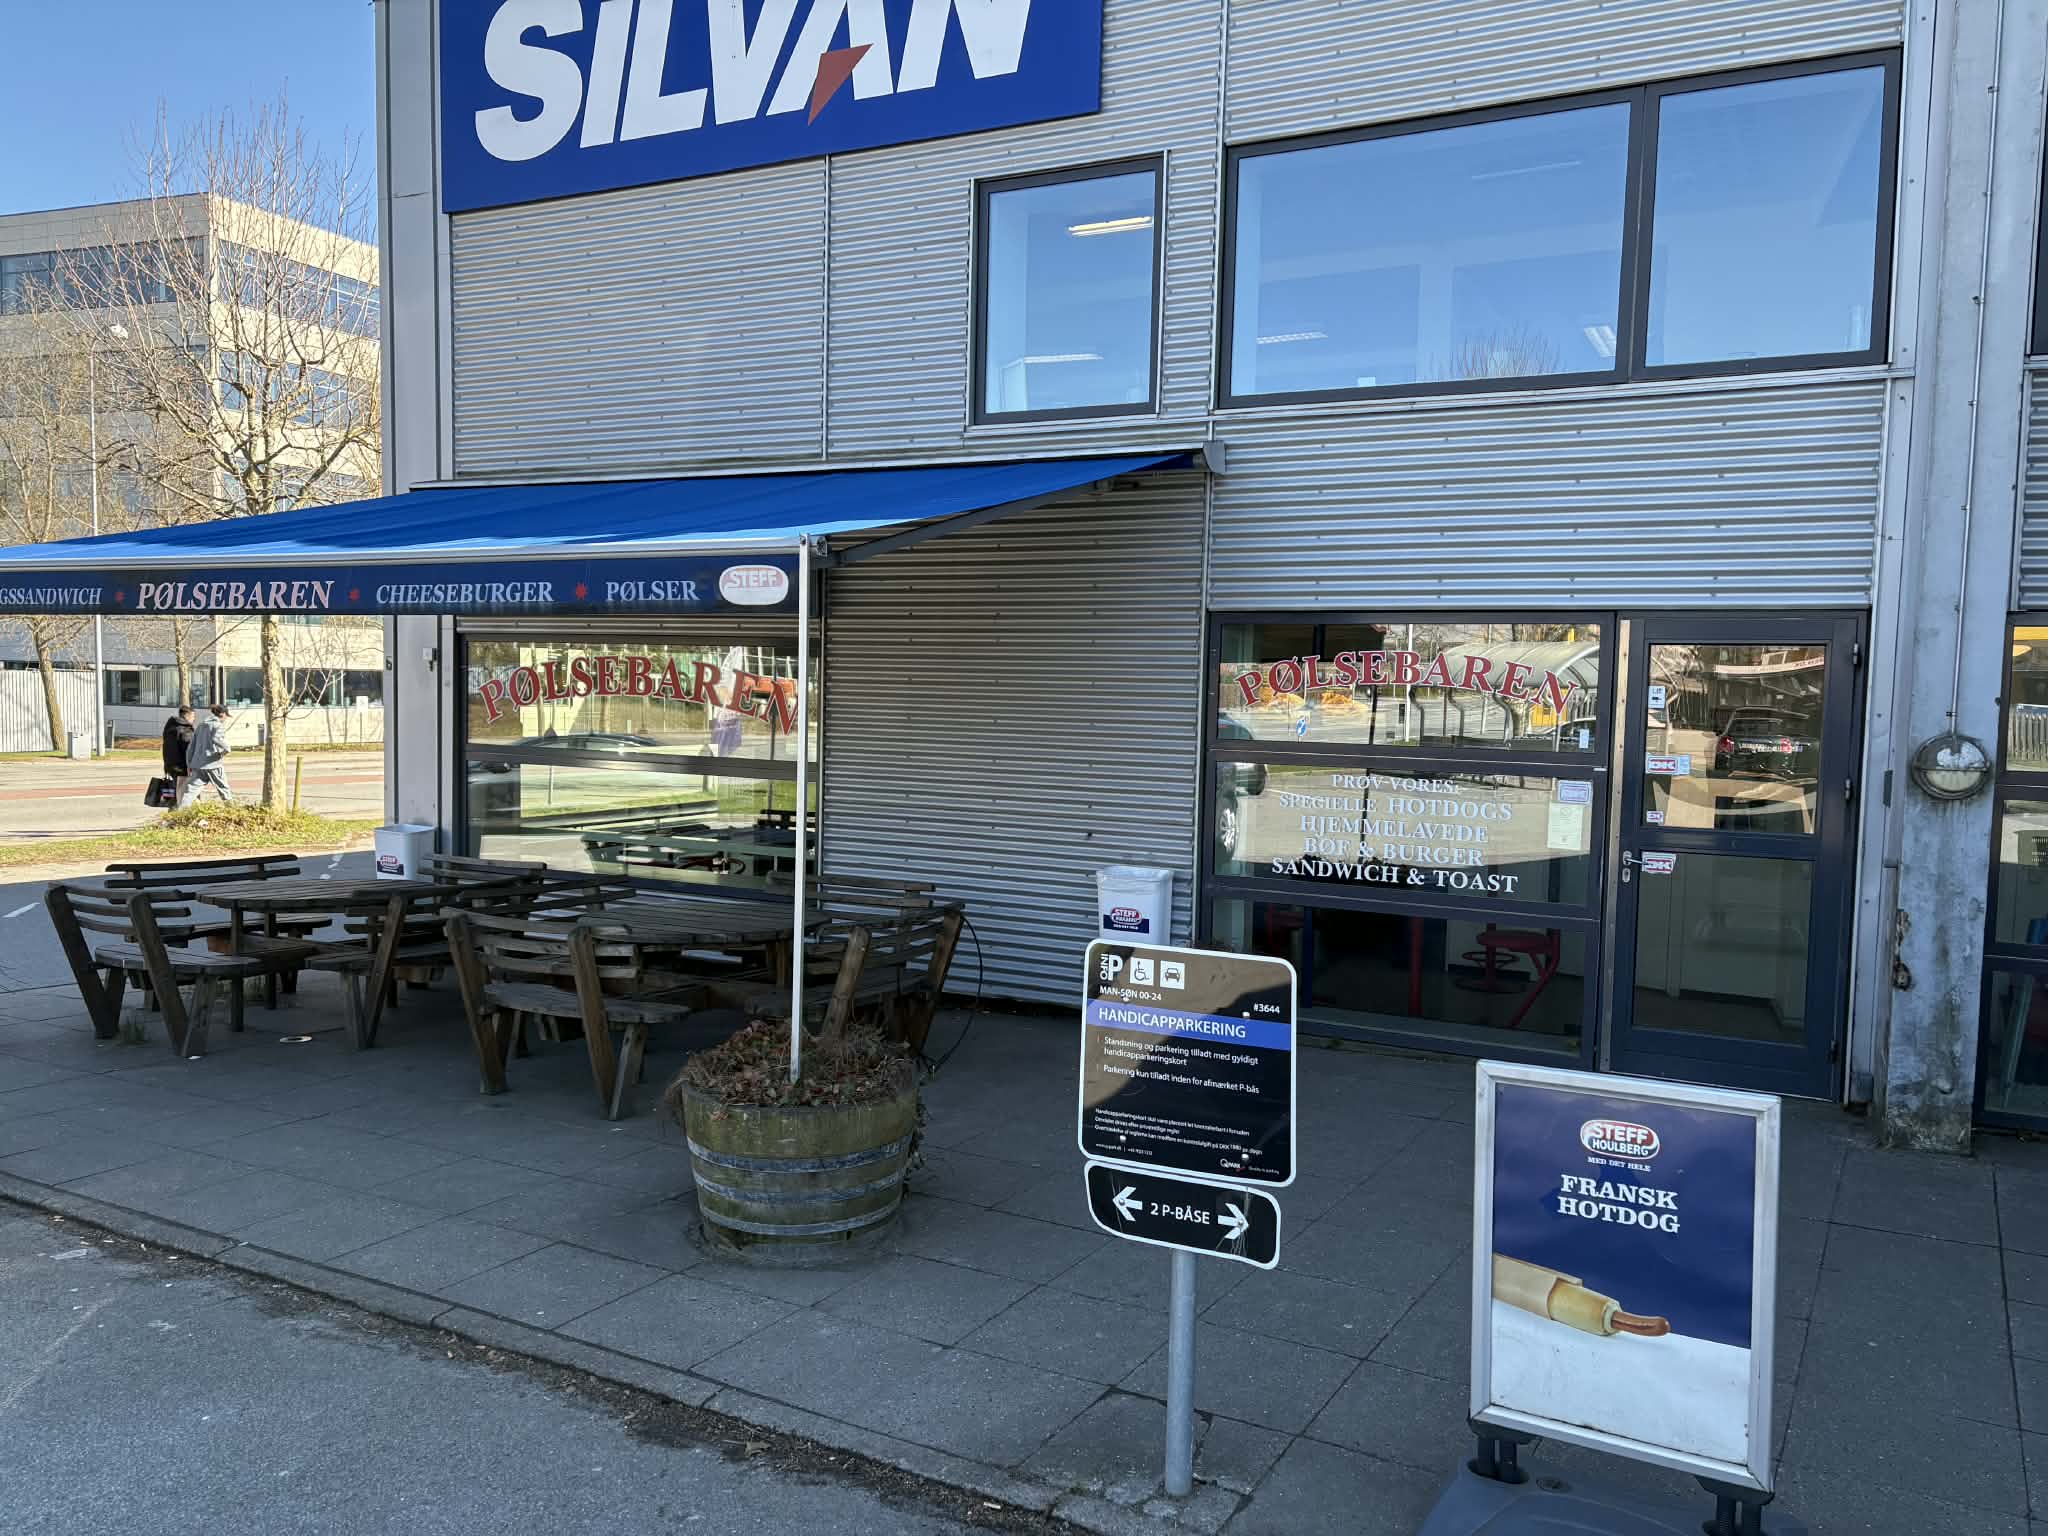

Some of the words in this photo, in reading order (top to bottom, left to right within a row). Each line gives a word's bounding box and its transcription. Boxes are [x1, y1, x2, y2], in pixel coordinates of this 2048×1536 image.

[135, 580, 335, 610] PØLSEBAREN
[375, 581, 554, 605] CHEESEBURGER
[605, 578, 700, 602] PØLSER
[726, 569, 778, 591] STEFF
[478, 655, 799, 737] PØLSEBAREN
[1234, 650, 1579, 715] PØLSEBAREN
[1279, 793, 1377, 813] SPECIELLE
[1388, 794, 1513, 821] HOTDOGS
[1300, 815, 1489, 844] HJEMMELAVEDE
[1303, 836, 1352, 857] BØF
[1358, 841, 1376, 858] &
[1383, 845, 1484, 867] BURGER
[1271, 857, 1399, 884] SANDWICH
[1407, 867, 1426, 886] &
[1433, 869, 1519, 893] TOAST
[1100, 953, 1109, 980] INFO
[1108, 954, 1124, 981] P
[1100, 986, 1138, 998] MAN-SØN
[1139, 991, 1162, 1001] 00-24
[1099, 1007, 1246, 1038] HANDICAPPARKERING
[1253, 1003, 1280, 1014] #3644
[1104, 1036, 1143, 1050] Standsning
[1144, 1043, 1154, 1052] og
[1155, 1044, 1189, 1057] parkering
[1191, 1047, 1212, 1058] tilladt
[1213, 1052, 1231, 1061] med
[1231, 1053, 1259, 1066] gyldigt
[1103, 1064, 1135, 1078] Parkering
[1136, 1069, 1149, 1078] kun
[1150, 1070, 1170, 1082] tilladt
[1171, 1074, 1192, 1084] inden
[1192, 1076, 1203, 1086] for
[1203, 1079, 1239, 1091] afmærket
[1239, 1083, 1260, 1094] P-bås
[1588, 1122, 1649, 1144] STEFF
[1592, 1138, 1649, 1156] HOULBERG
[1587, 1156, 1607, 1165] MED
[1609, 1160, 1625, 1168] DET
[1560, 1174, 1679, 1210] FRANSK
[1150, 1202, 1159, 1216] 2
[1161, 1203, 1211, 1225] P-BÅSE
[1557, 1196, 1681, 1234] HOTDOG
